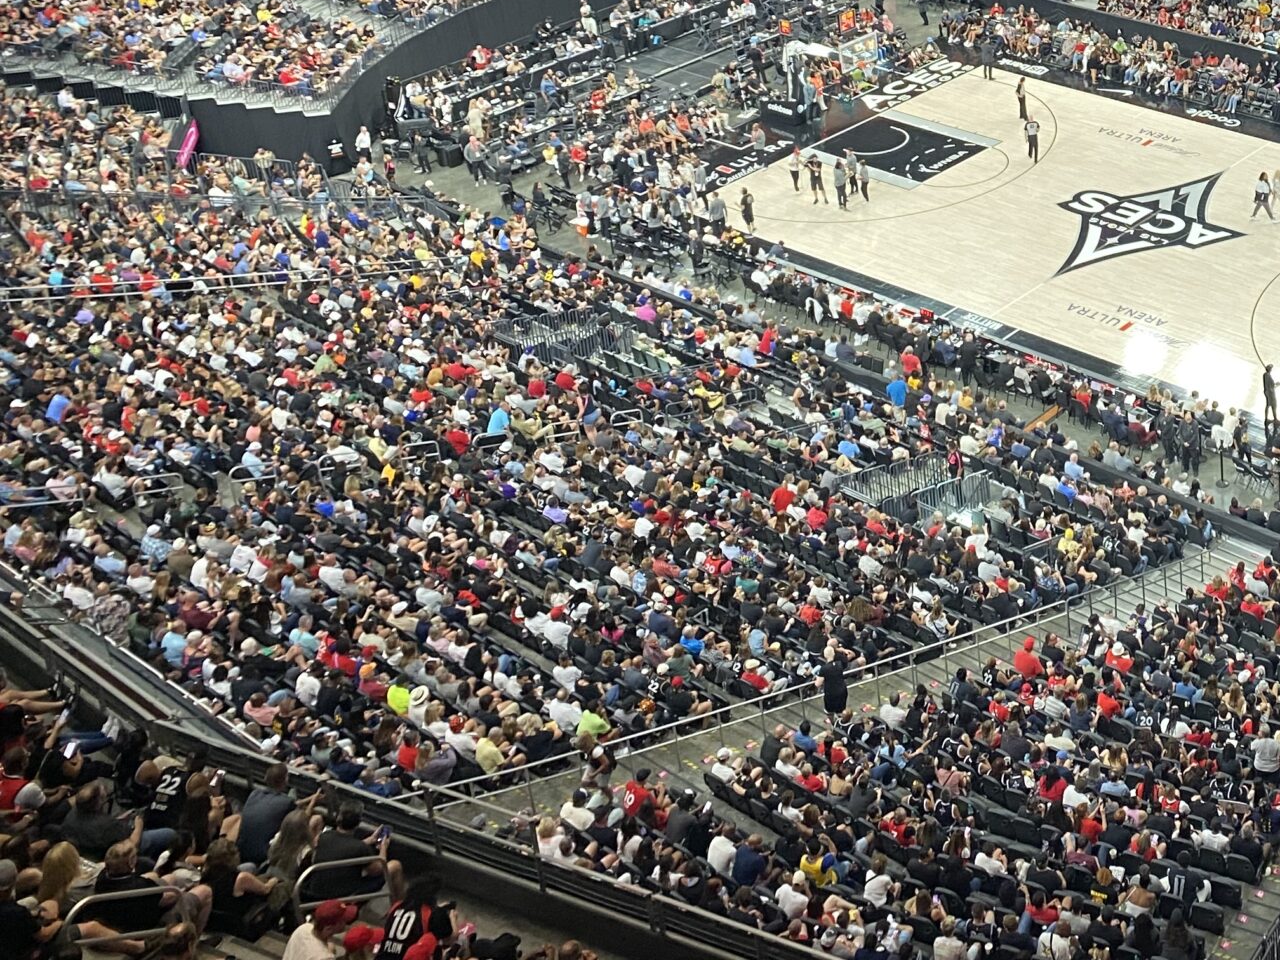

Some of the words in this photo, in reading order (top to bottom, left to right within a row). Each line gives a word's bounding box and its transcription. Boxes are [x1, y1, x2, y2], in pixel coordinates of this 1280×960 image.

[860, 58, 964, 111] ACES
[872, 94, 913, 112] LAS
[913, 64, 975, 93] VEGAS
[1186, 108, 1241, 127] Google
[1099, 127, 1143, 144] ULTRA
[1138, 127, 1182, 143] ARENA
[929, 149, 970, 171] WNBA
[1068, 192, 1232, 246] ACES
[1088, 217, 1135, 235] VEGAS
[1140, 232, 1169, 245] LAS
[1068, 303, 1121, 326] ULTRA
[1117, 305, 1169, 326] ARENA
[1140, 716, 1153, 727] 20
[155, 774, 181, 796] 22
[388, 908, 416, 941] 10
